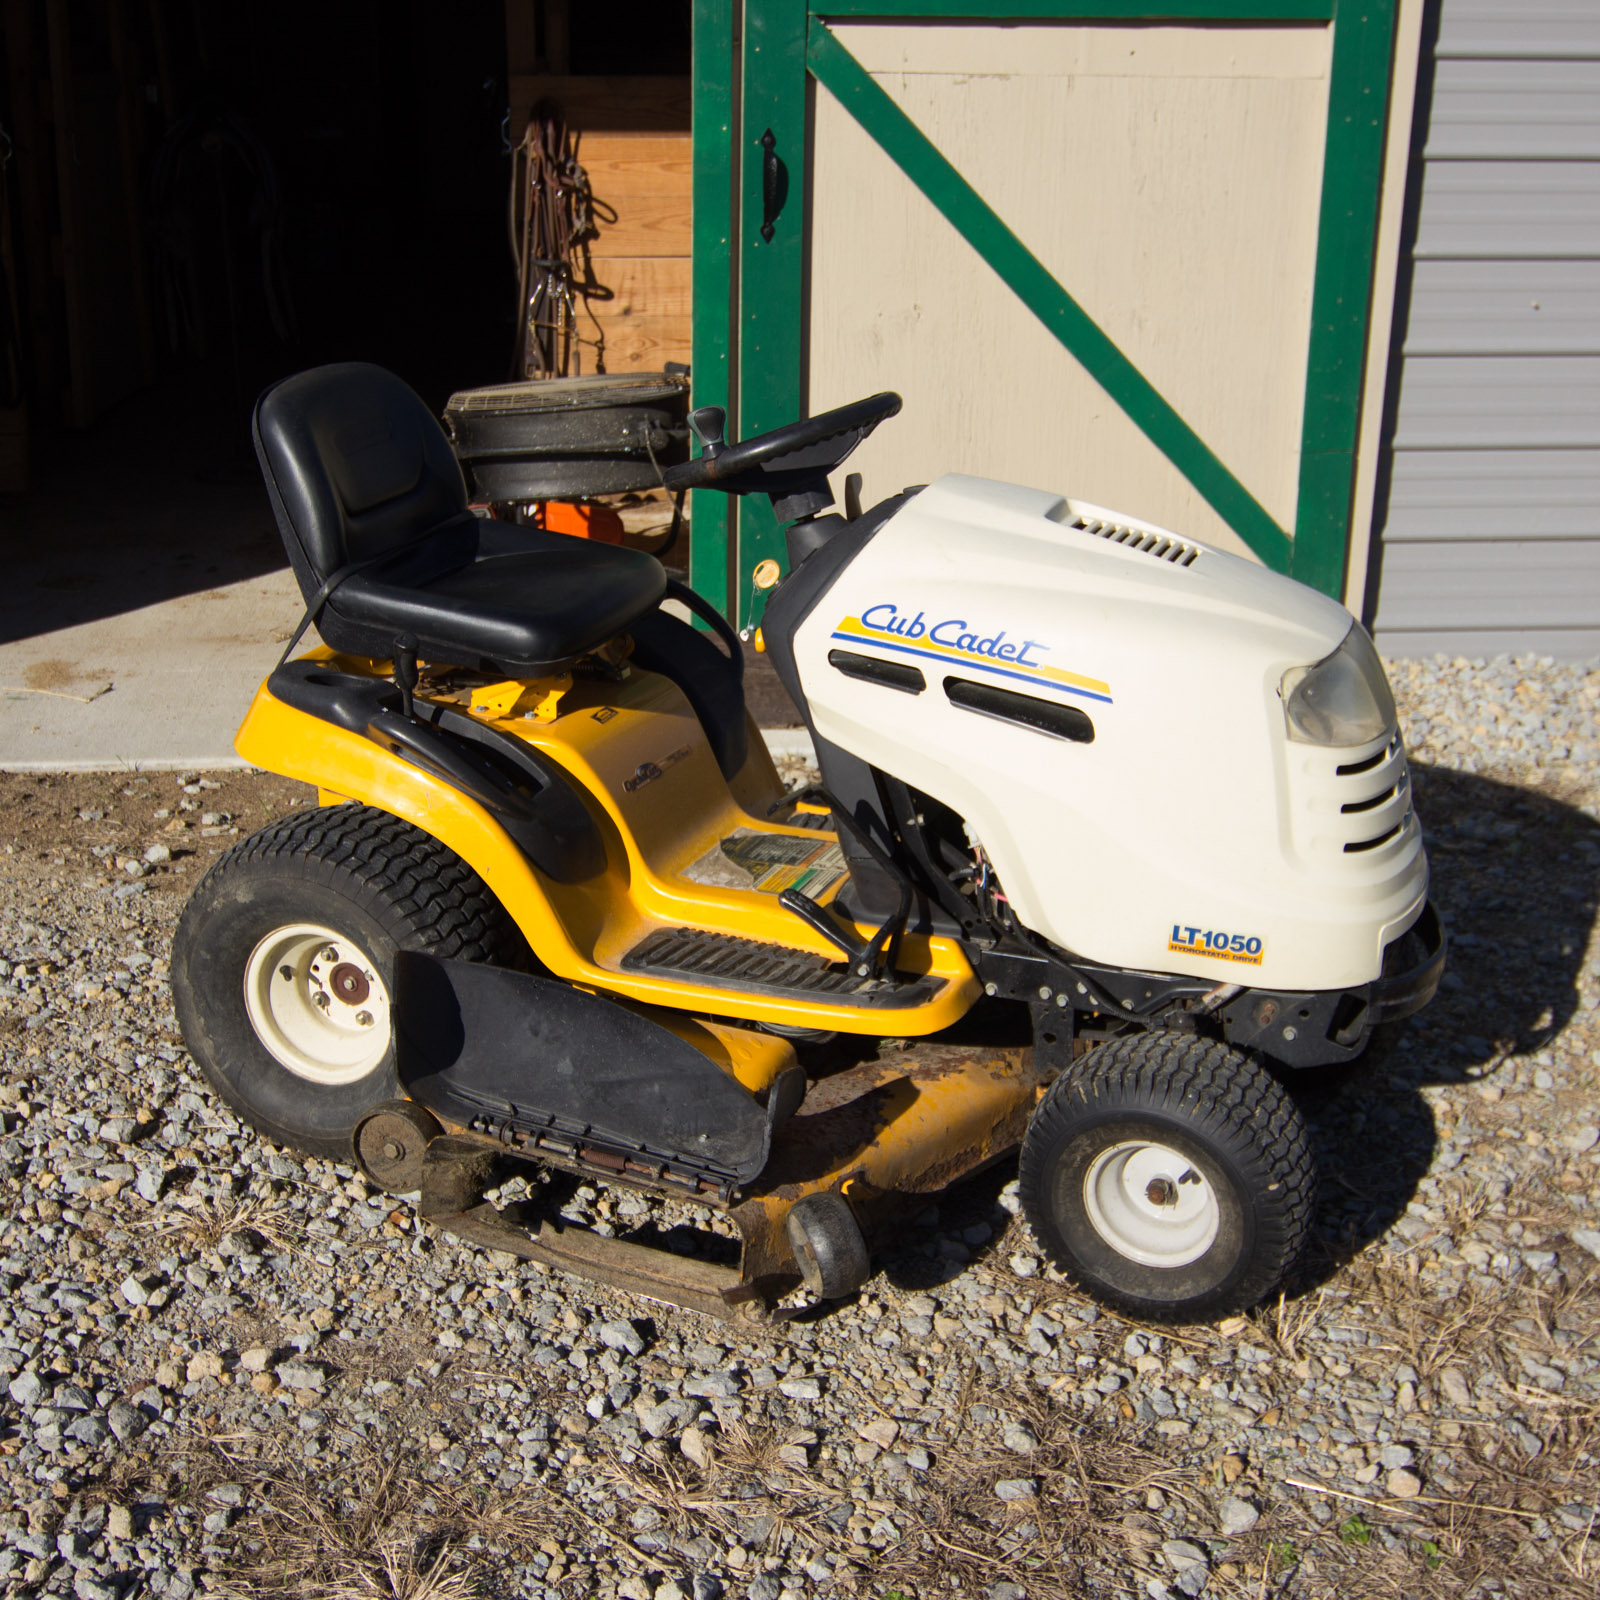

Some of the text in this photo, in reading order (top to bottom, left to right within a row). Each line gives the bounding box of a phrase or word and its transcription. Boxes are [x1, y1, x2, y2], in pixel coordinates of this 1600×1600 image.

[861, 604, 1051, 668] Cub Cadet
[1170, 945, 1259, 964] HYDROSTATIC DRIVE
